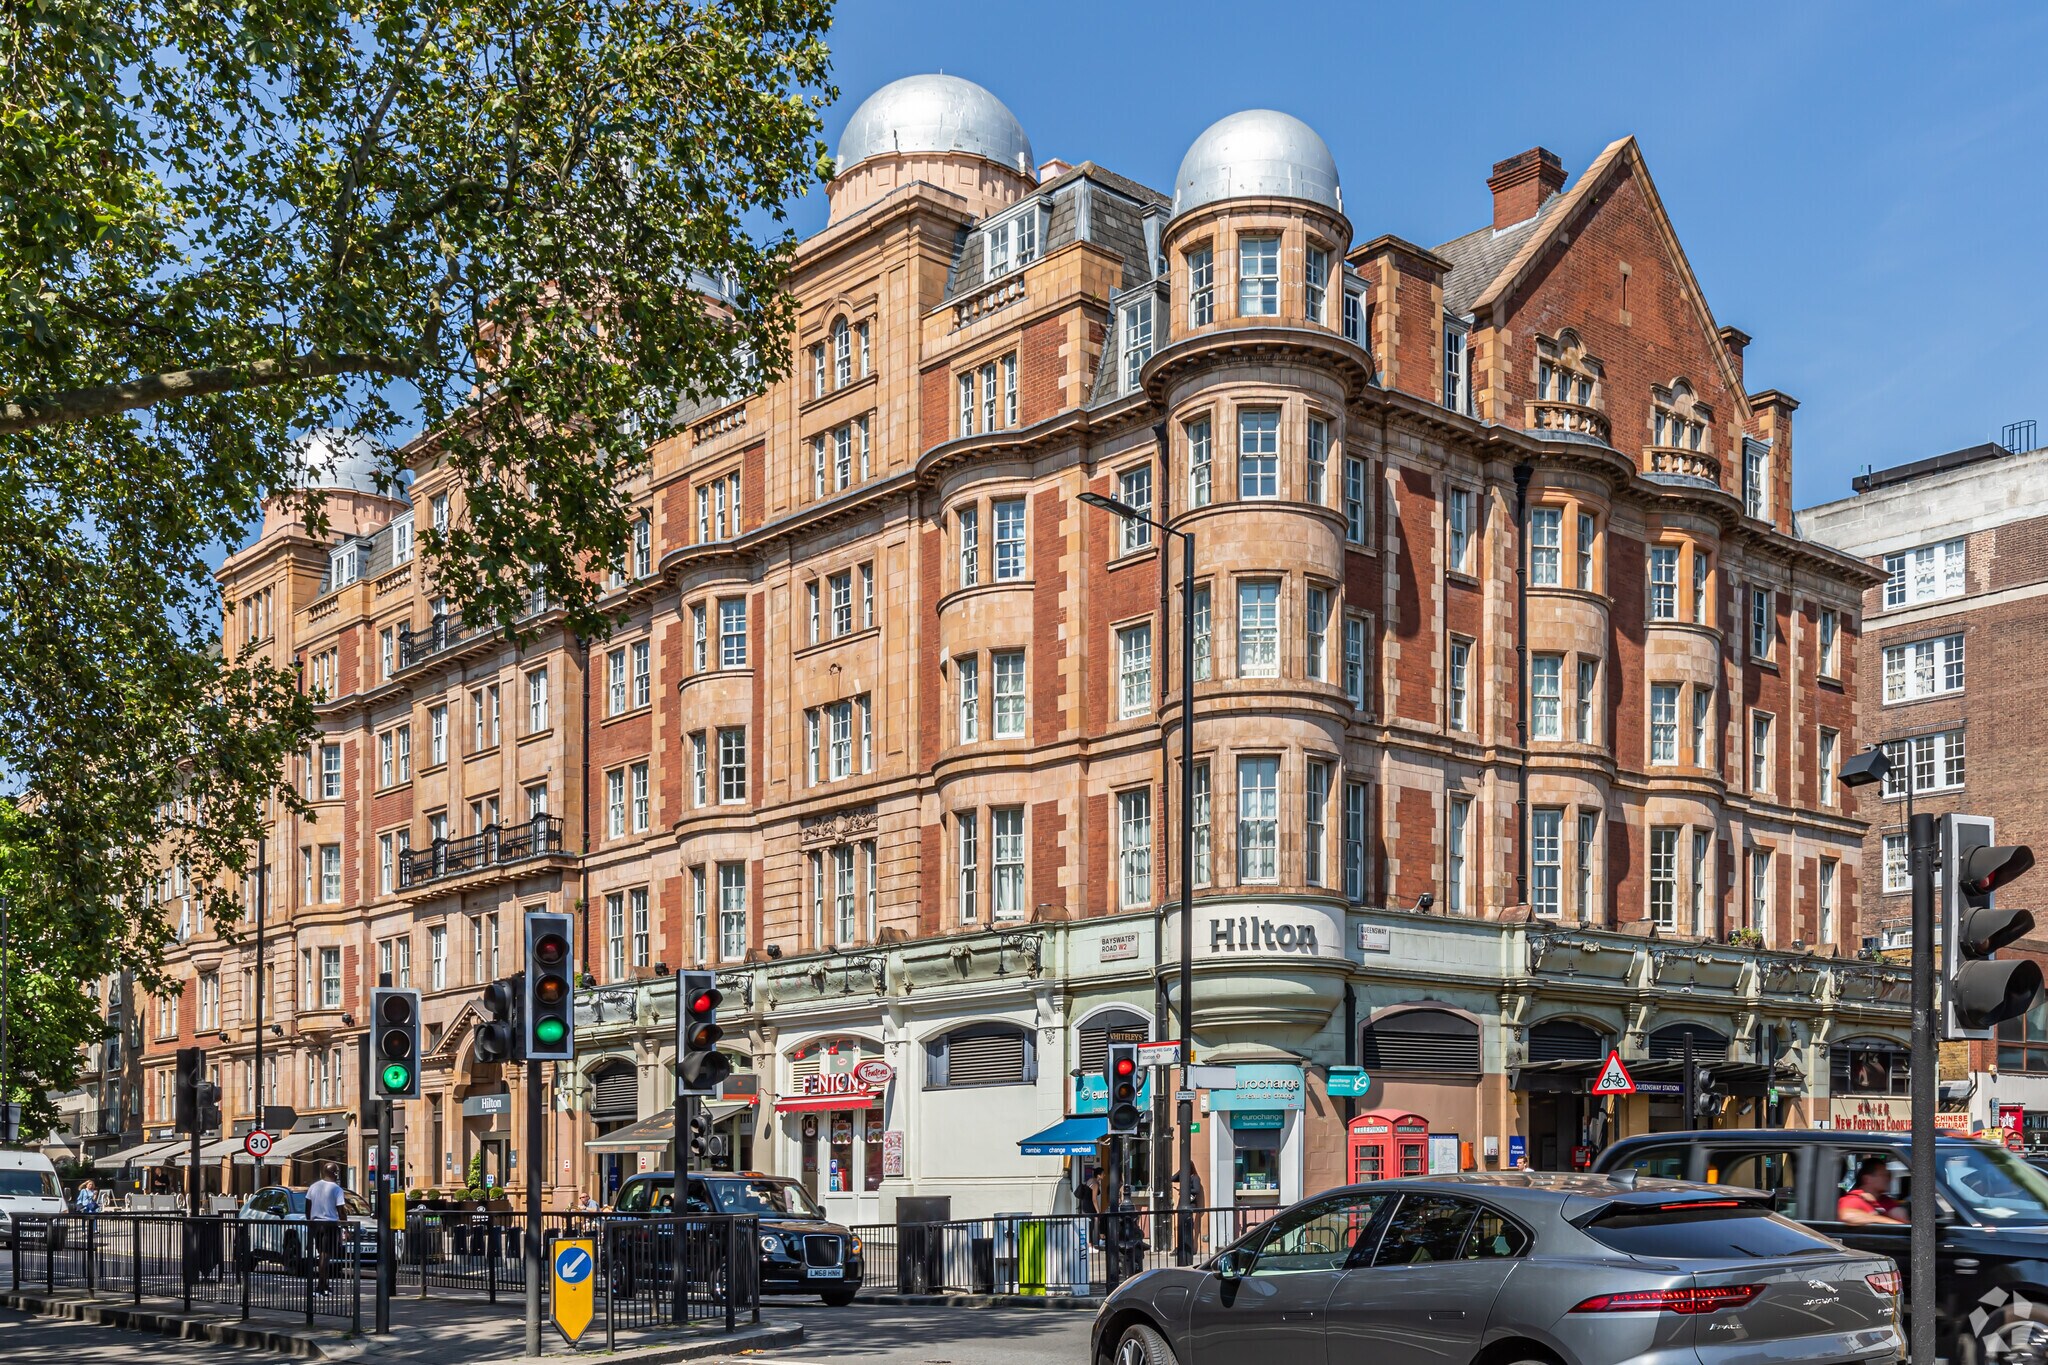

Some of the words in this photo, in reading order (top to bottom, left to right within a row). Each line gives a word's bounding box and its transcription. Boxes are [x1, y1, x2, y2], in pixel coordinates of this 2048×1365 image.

[1209, 916, 1316, 948] Hilton
[1360, 927, 1387, 935] QUEENSWAY
[1101, 935, 1136, 945] BAYSWATER
[1101, 944, 1117, 952] ROAD
[864, 1065, 888, 1077] Fentons
[1236, 1079, 1299, 1091] urochange
[1274, 1093, 1295, 1101] change
[481, 1097, 502, 1108] Hilton
[1241, 1113, 1283, 1121] eurochange
[250, 1138, 268, 1149] 30
[1048, 1147, 1066, 1155] change
[1803, 1297, 1839, 1306] JAGUAR
